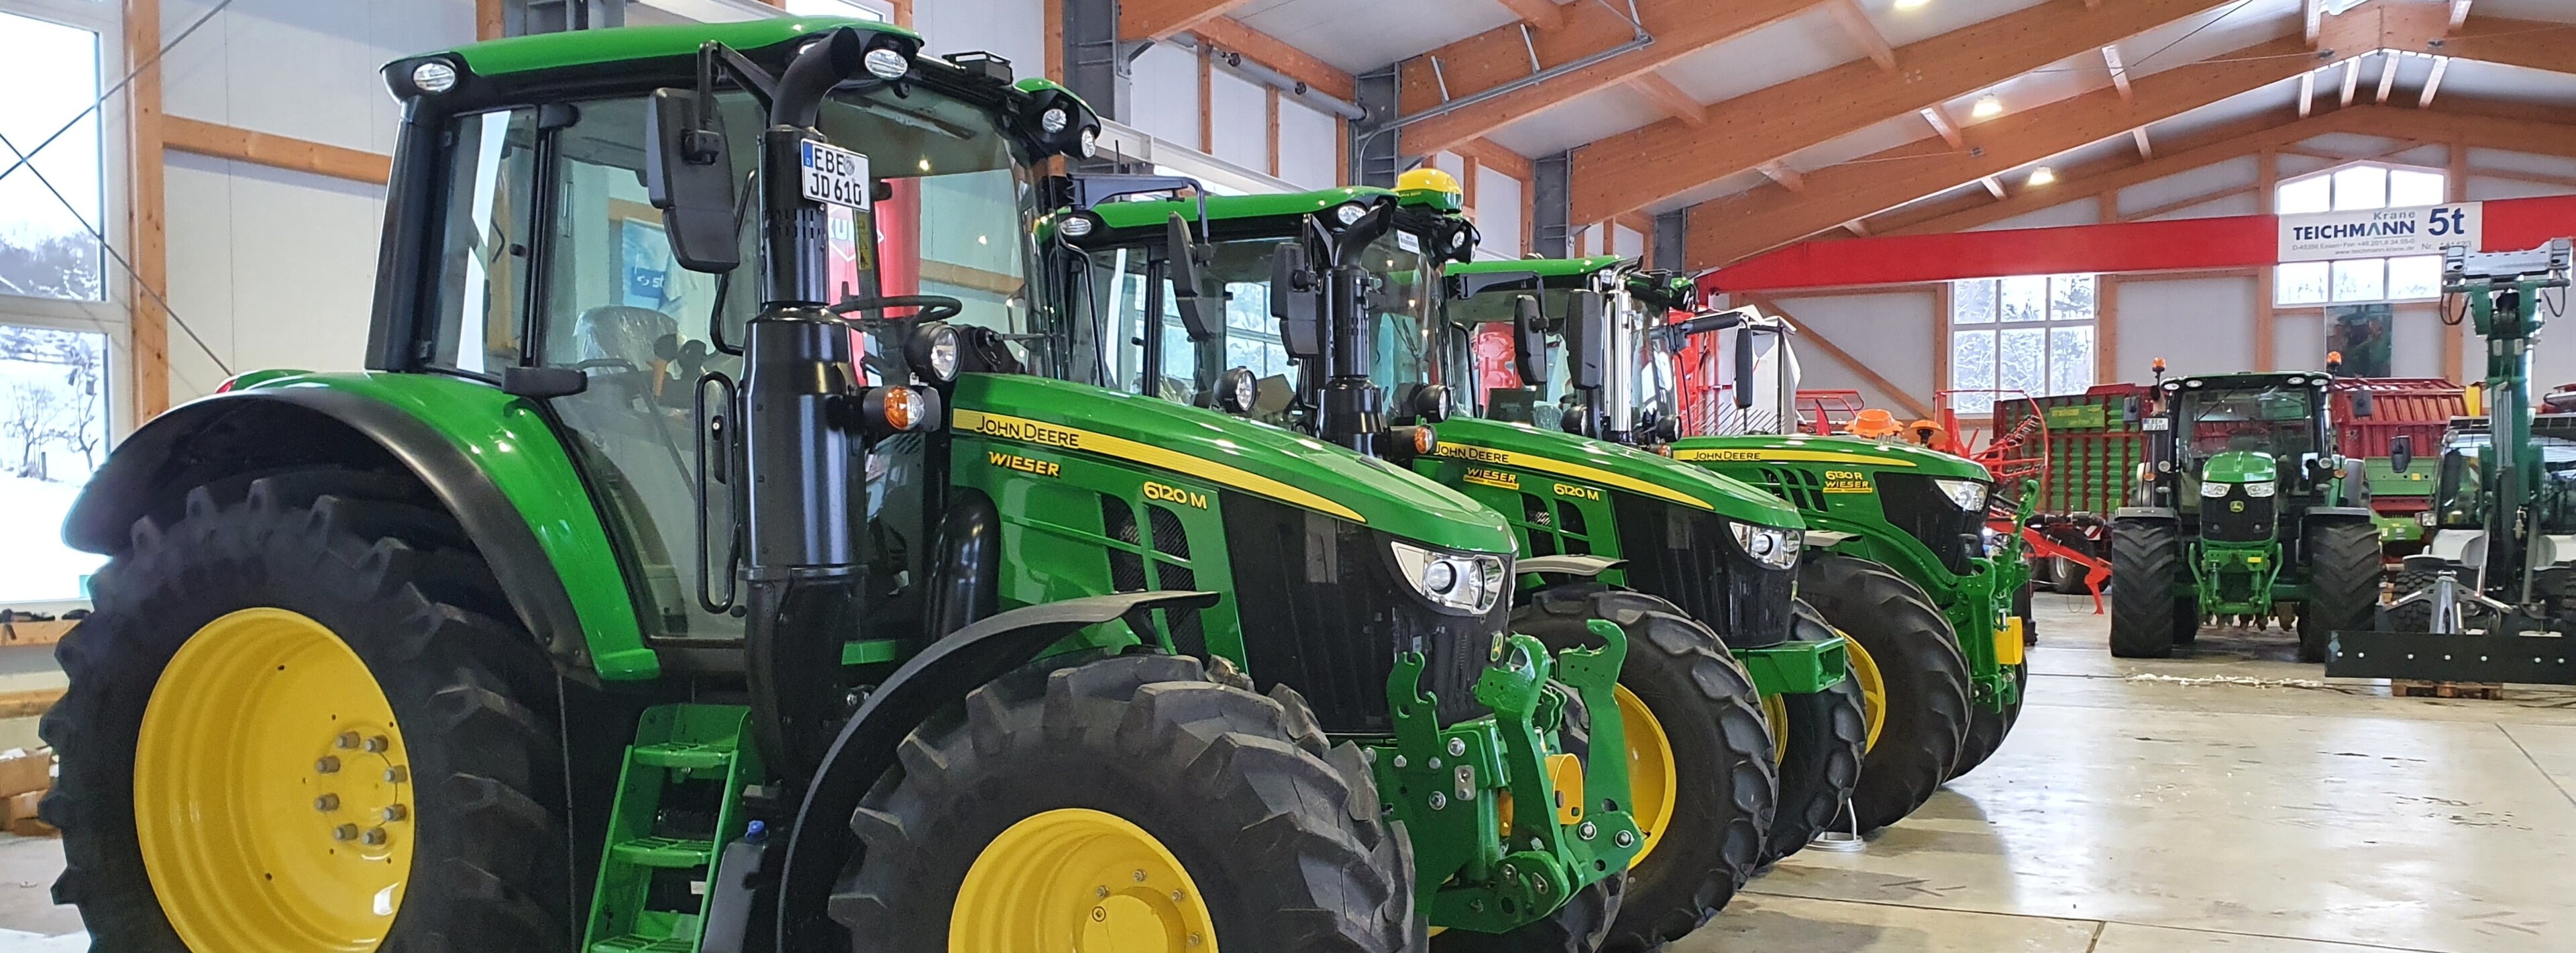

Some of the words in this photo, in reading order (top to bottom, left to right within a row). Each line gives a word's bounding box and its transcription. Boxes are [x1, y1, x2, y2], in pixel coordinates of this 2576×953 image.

[814, 148, 846, 177] EBE
[810, 172, 830, 198] JD
[835, 178, 861, 205] 610
[2373, 211, 2416, 220] Krane
[2428, 207, 2465, 236] 5t
[2293, 220, 2416, 240] TEICHMANN
[976, 415, 1020, 437] JOHN
[1024, 423, 1079, 446] DEERE
[988, 451, 1060, 476] WIESER
[1436, 444, 1466, 456] JOHN
[1469, 448, 1509, 463] DEERE
[1693, 451, 1722, 460] JOHN
[1724, 451, 1761, 460] DEERE
[1467, 467, 1516, 483] WIESER
[1825, 470, 1853, 480] 6130
[1854, 472, 1863, 480] R
[1143, 481, 1187, 503] 6120
[1190, 492, 1208, 509] M
[1554, 483, 1585, 497] 6120
[1587, 490, 1599, 501] M
